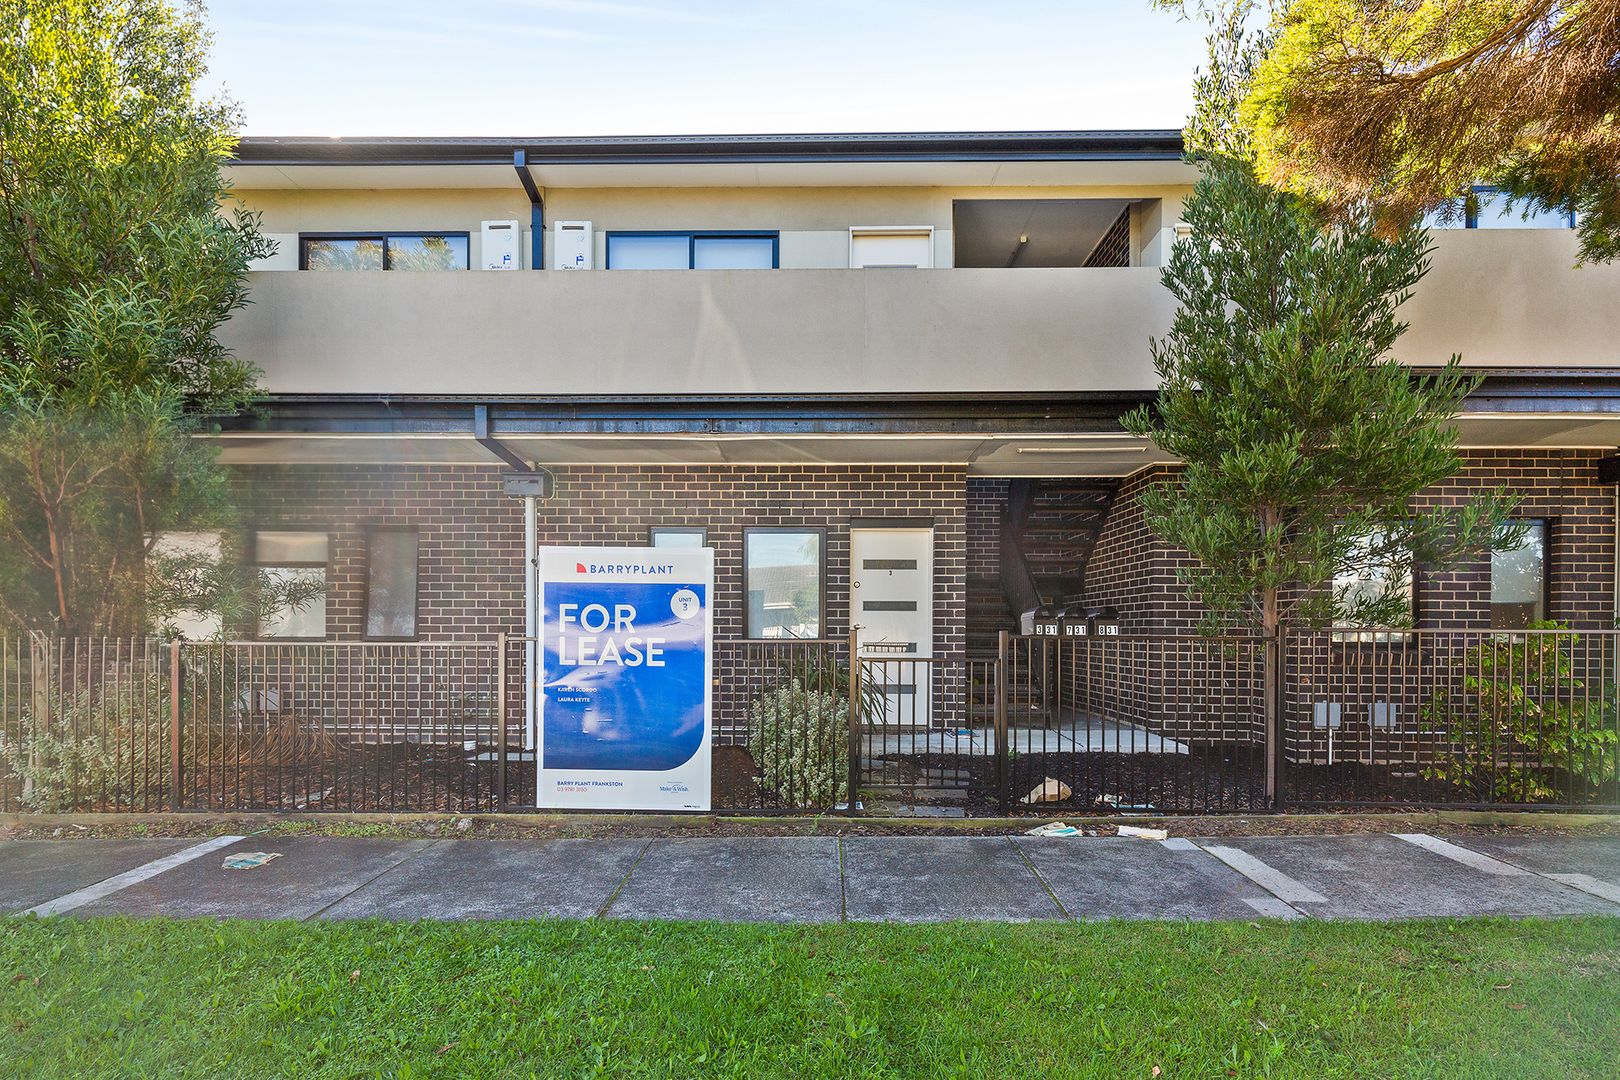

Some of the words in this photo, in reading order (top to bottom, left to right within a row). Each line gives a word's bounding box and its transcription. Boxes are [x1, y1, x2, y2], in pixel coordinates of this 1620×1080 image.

[590, 564, 674, 575] BARRYPLANT
[682, 602, 688, 612] 3
[559, 603, 637, 634] FOR
[1046, 625, 1057, 634] 31
[1075, 626, 1086, 635] 31
[1099, 626, 1105, 635] 8
[1107, 626, 1118, 635] 31
[559, 636, 666, 667] LEASE
